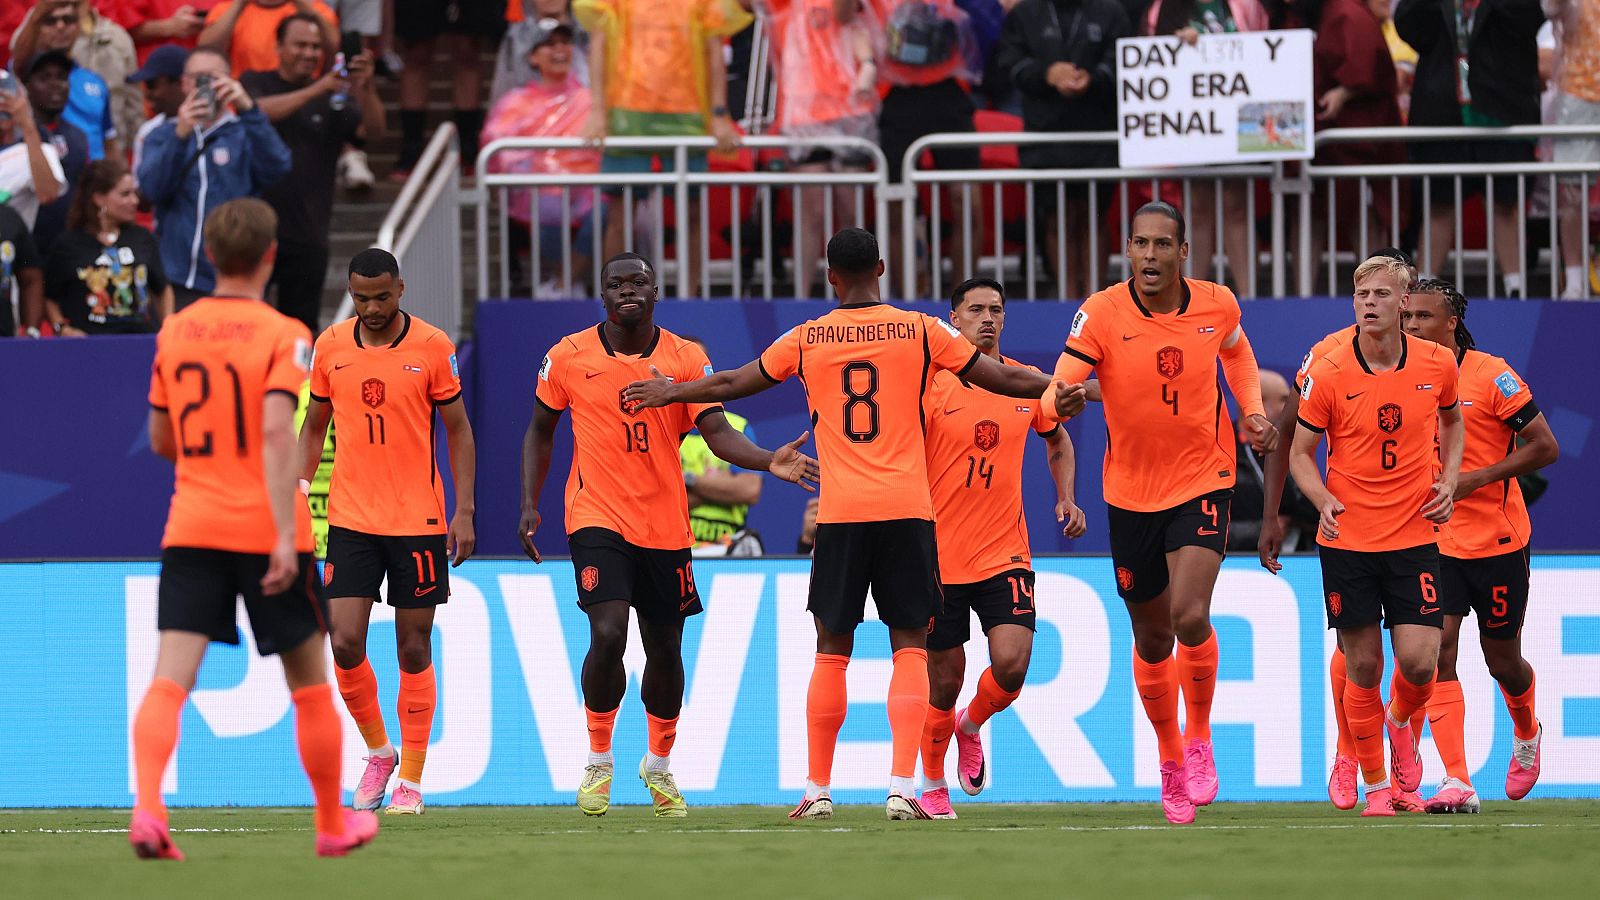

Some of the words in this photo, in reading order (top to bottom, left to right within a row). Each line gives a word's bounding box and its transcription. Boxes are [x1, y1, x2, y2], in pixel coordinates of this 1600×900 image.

[1122, 42, 1182, 68] DAY
[1264, 37, 1283, 61] Y
[1123, 77, 1169, 102] NO
[1192, 73, 1249, 97] ERA
[1124, 110, 1223, 138] PENAL
[806, 322, 916, 344] GRAVENBERCH
[175, 361, 248, 457] 21
[841, 360, 880, 443] 8
[1162, 384, 1178, 416] 4
[365, 413, 385, 445] 11
[622, 421, 649, 452] 19
[1381, 439, 1398, 470] 6
[965, 455, 995, 489] 14
[1201, 499, 1218, 527] 4
[412, 550, 435, 583] 11
[676, 561, 694, 597] 19
[1008, 576, 1034, 608] 14
[1419, 572, 1437, 602] 6
[1491, 586, 1508, 617] 5
